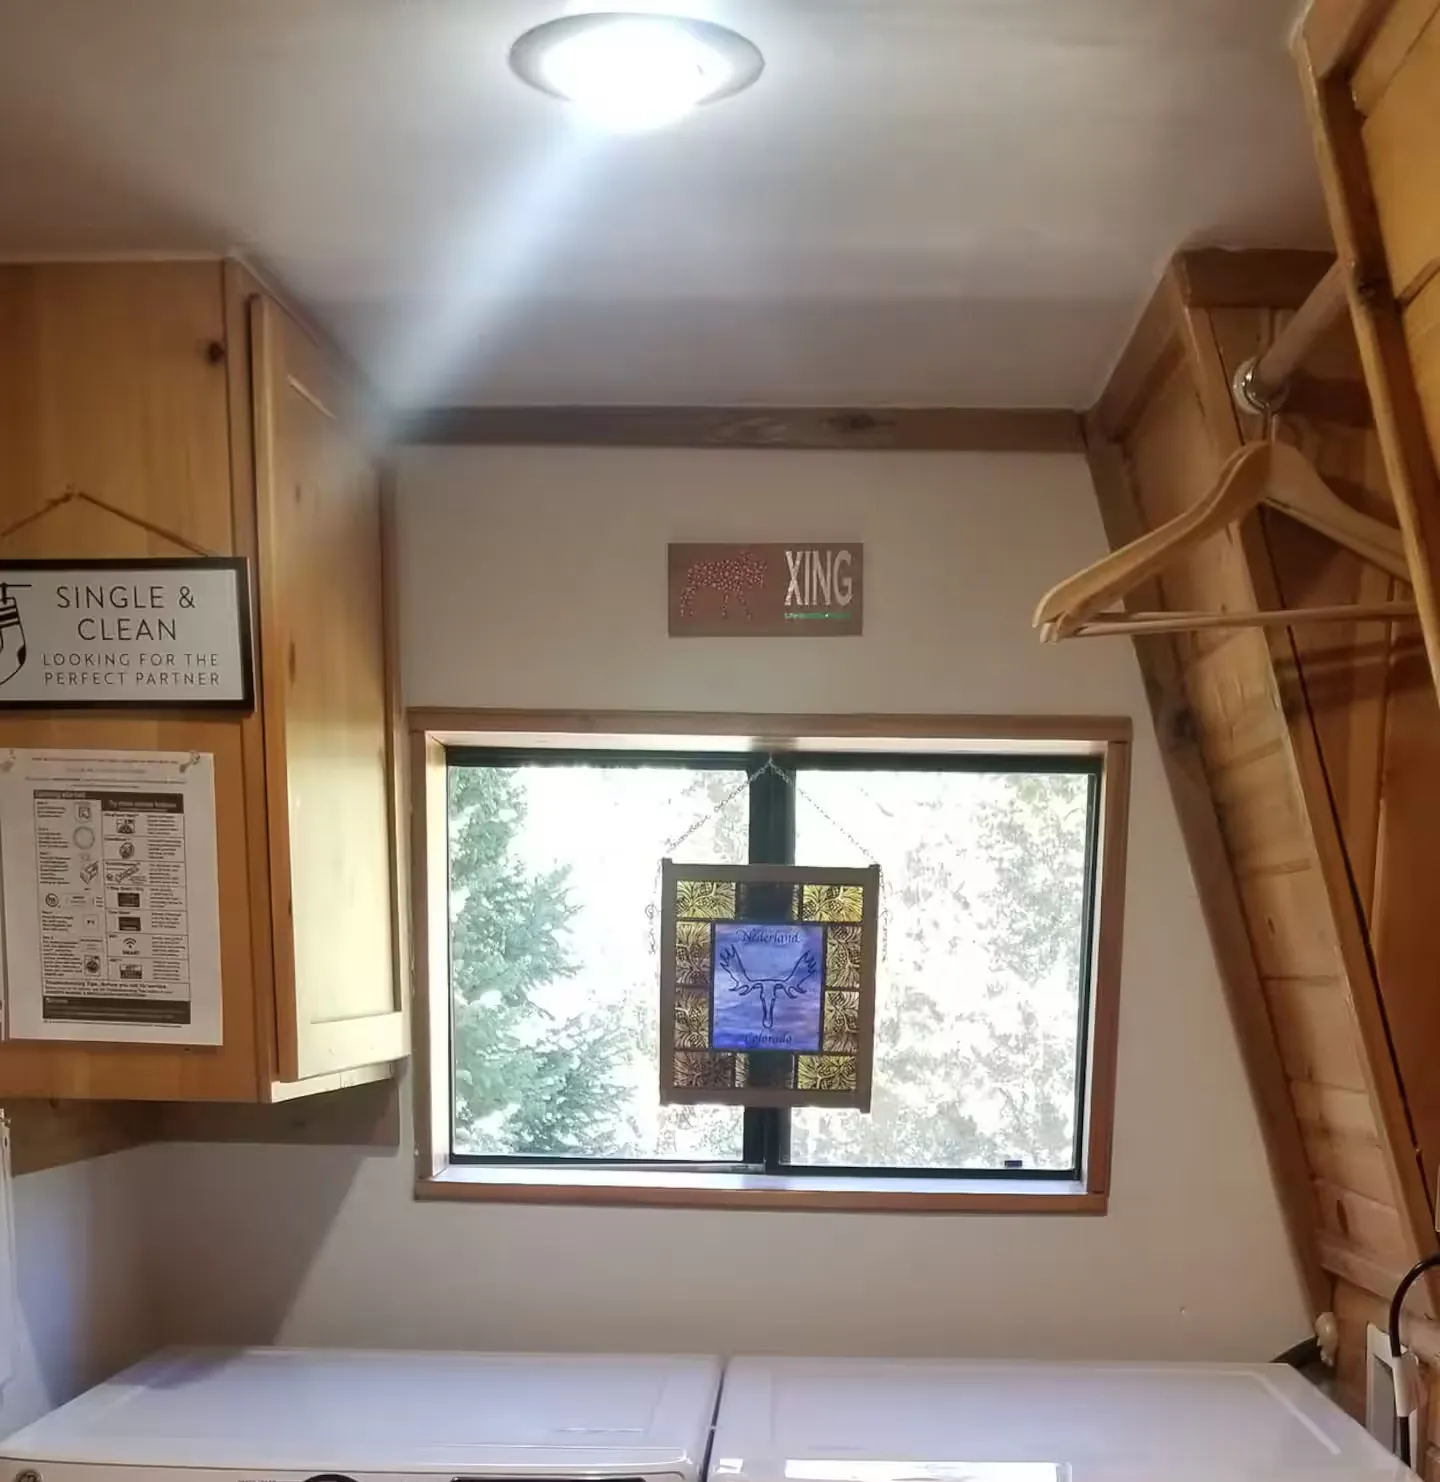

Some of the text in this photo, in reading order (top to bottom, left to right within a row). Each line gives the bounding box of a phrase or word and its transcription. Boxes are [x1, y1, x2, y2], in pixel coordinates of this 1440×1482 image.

[784, 550, 853, 606] XING
[56, 585, 196, 609] SINGLE &
[77, 618, 177, 641] CLEAN
[43, 653, 220, 667] LOOKING FOR THE
[44, 672, 220, 686] PERFECT PARTNER
[736, 928, 801, 945] Nederland
